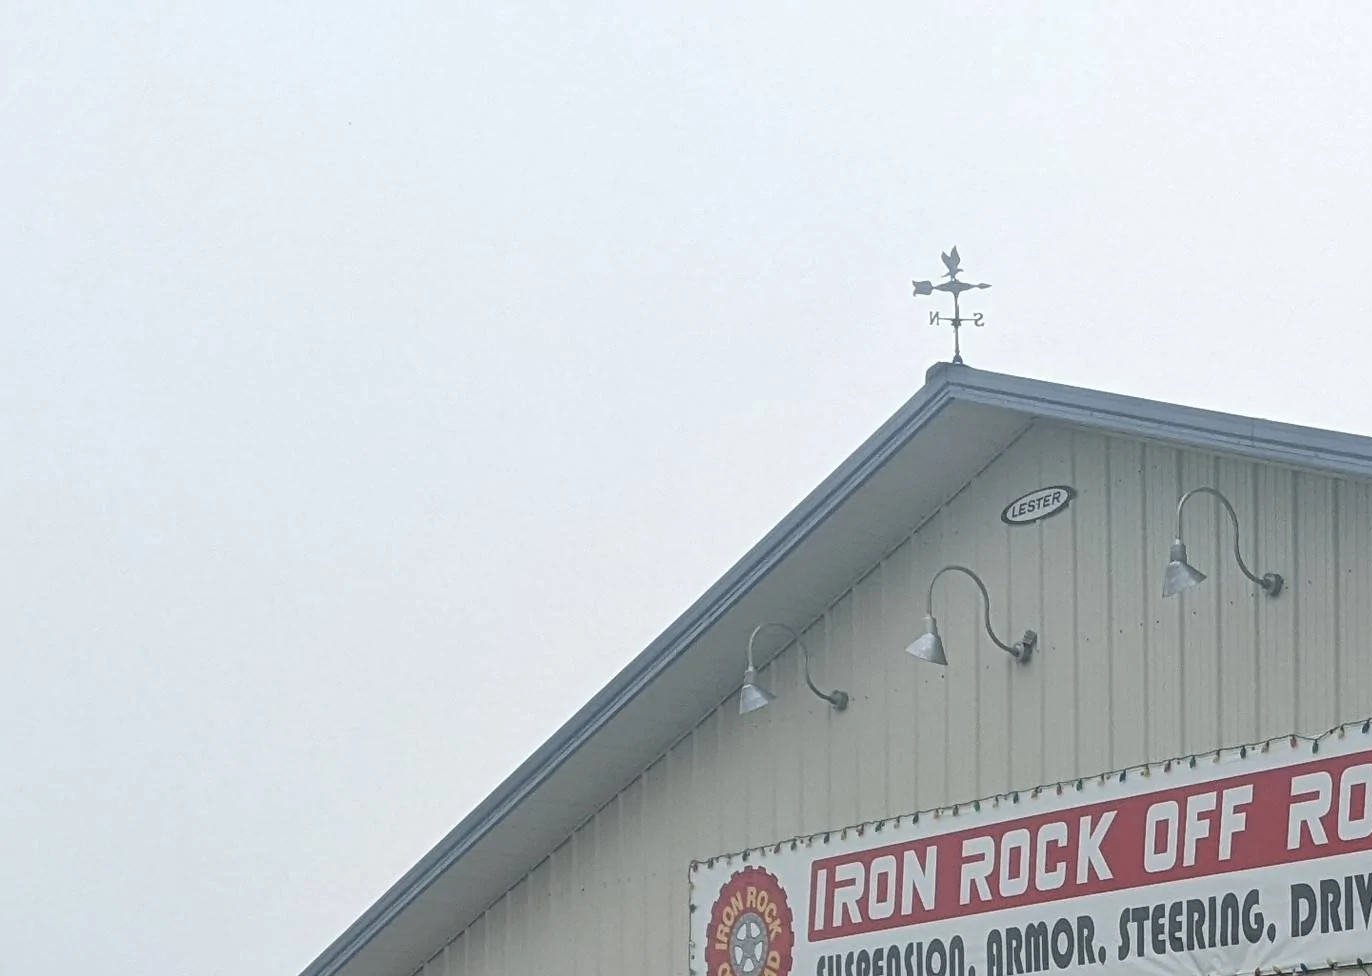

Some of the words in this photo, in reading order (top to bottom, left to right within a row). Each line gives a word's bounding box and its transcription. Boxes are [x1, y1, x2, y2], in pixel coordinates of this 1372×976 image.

[1011, 491, 1062, 518] LESTER
[814, 845, 938, 931] IRON
[959, 809, 1117, 905] ROCK
[1143, 784, 1254, 873] OFF
[715, 891, 744, 951] IRON
[746, 886, 782, 941] ROCK
